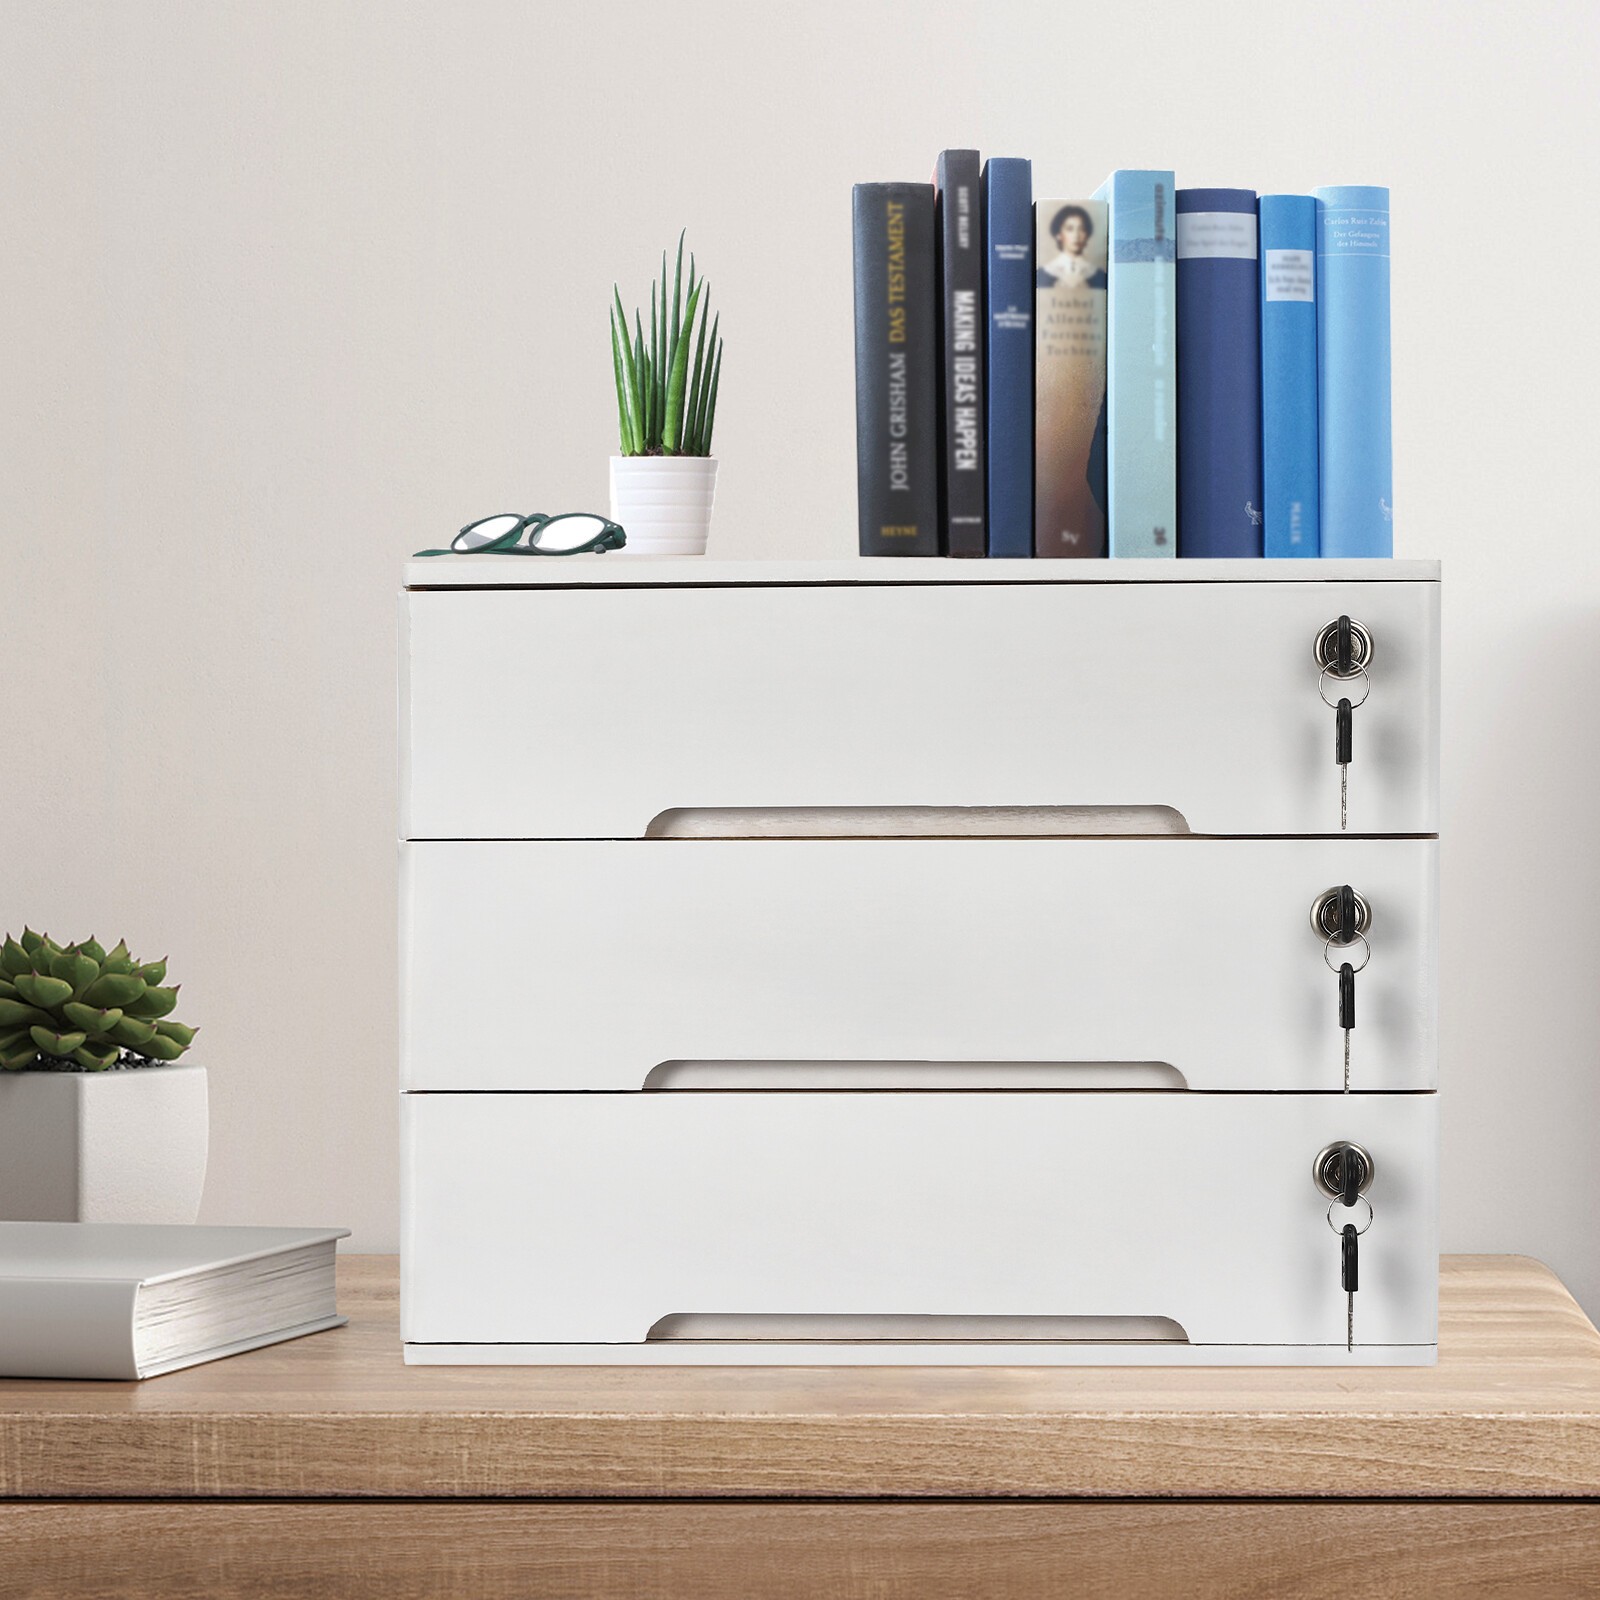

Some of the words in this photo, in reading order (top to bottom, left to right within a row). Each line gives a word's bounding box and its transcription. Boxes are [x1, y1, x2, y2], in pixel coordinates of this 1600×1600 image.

[1324, 217, 1349, 225] Carlos
[886, 202, 907, 304] TESTAMENT
[888, 307, 907, 343] DAS
[954, 290, 976, 352] MAKING
[1045, 313, 1099, 325] Allende
[1050, 297, 1094, 309] Isabel
[889, 353, 908, 438] GRISHAM
[954, 356, 977, 403] IDEAS
[954, 407, 977, 470] HAPPEN
[889, 442, 910, 491] JOHN
